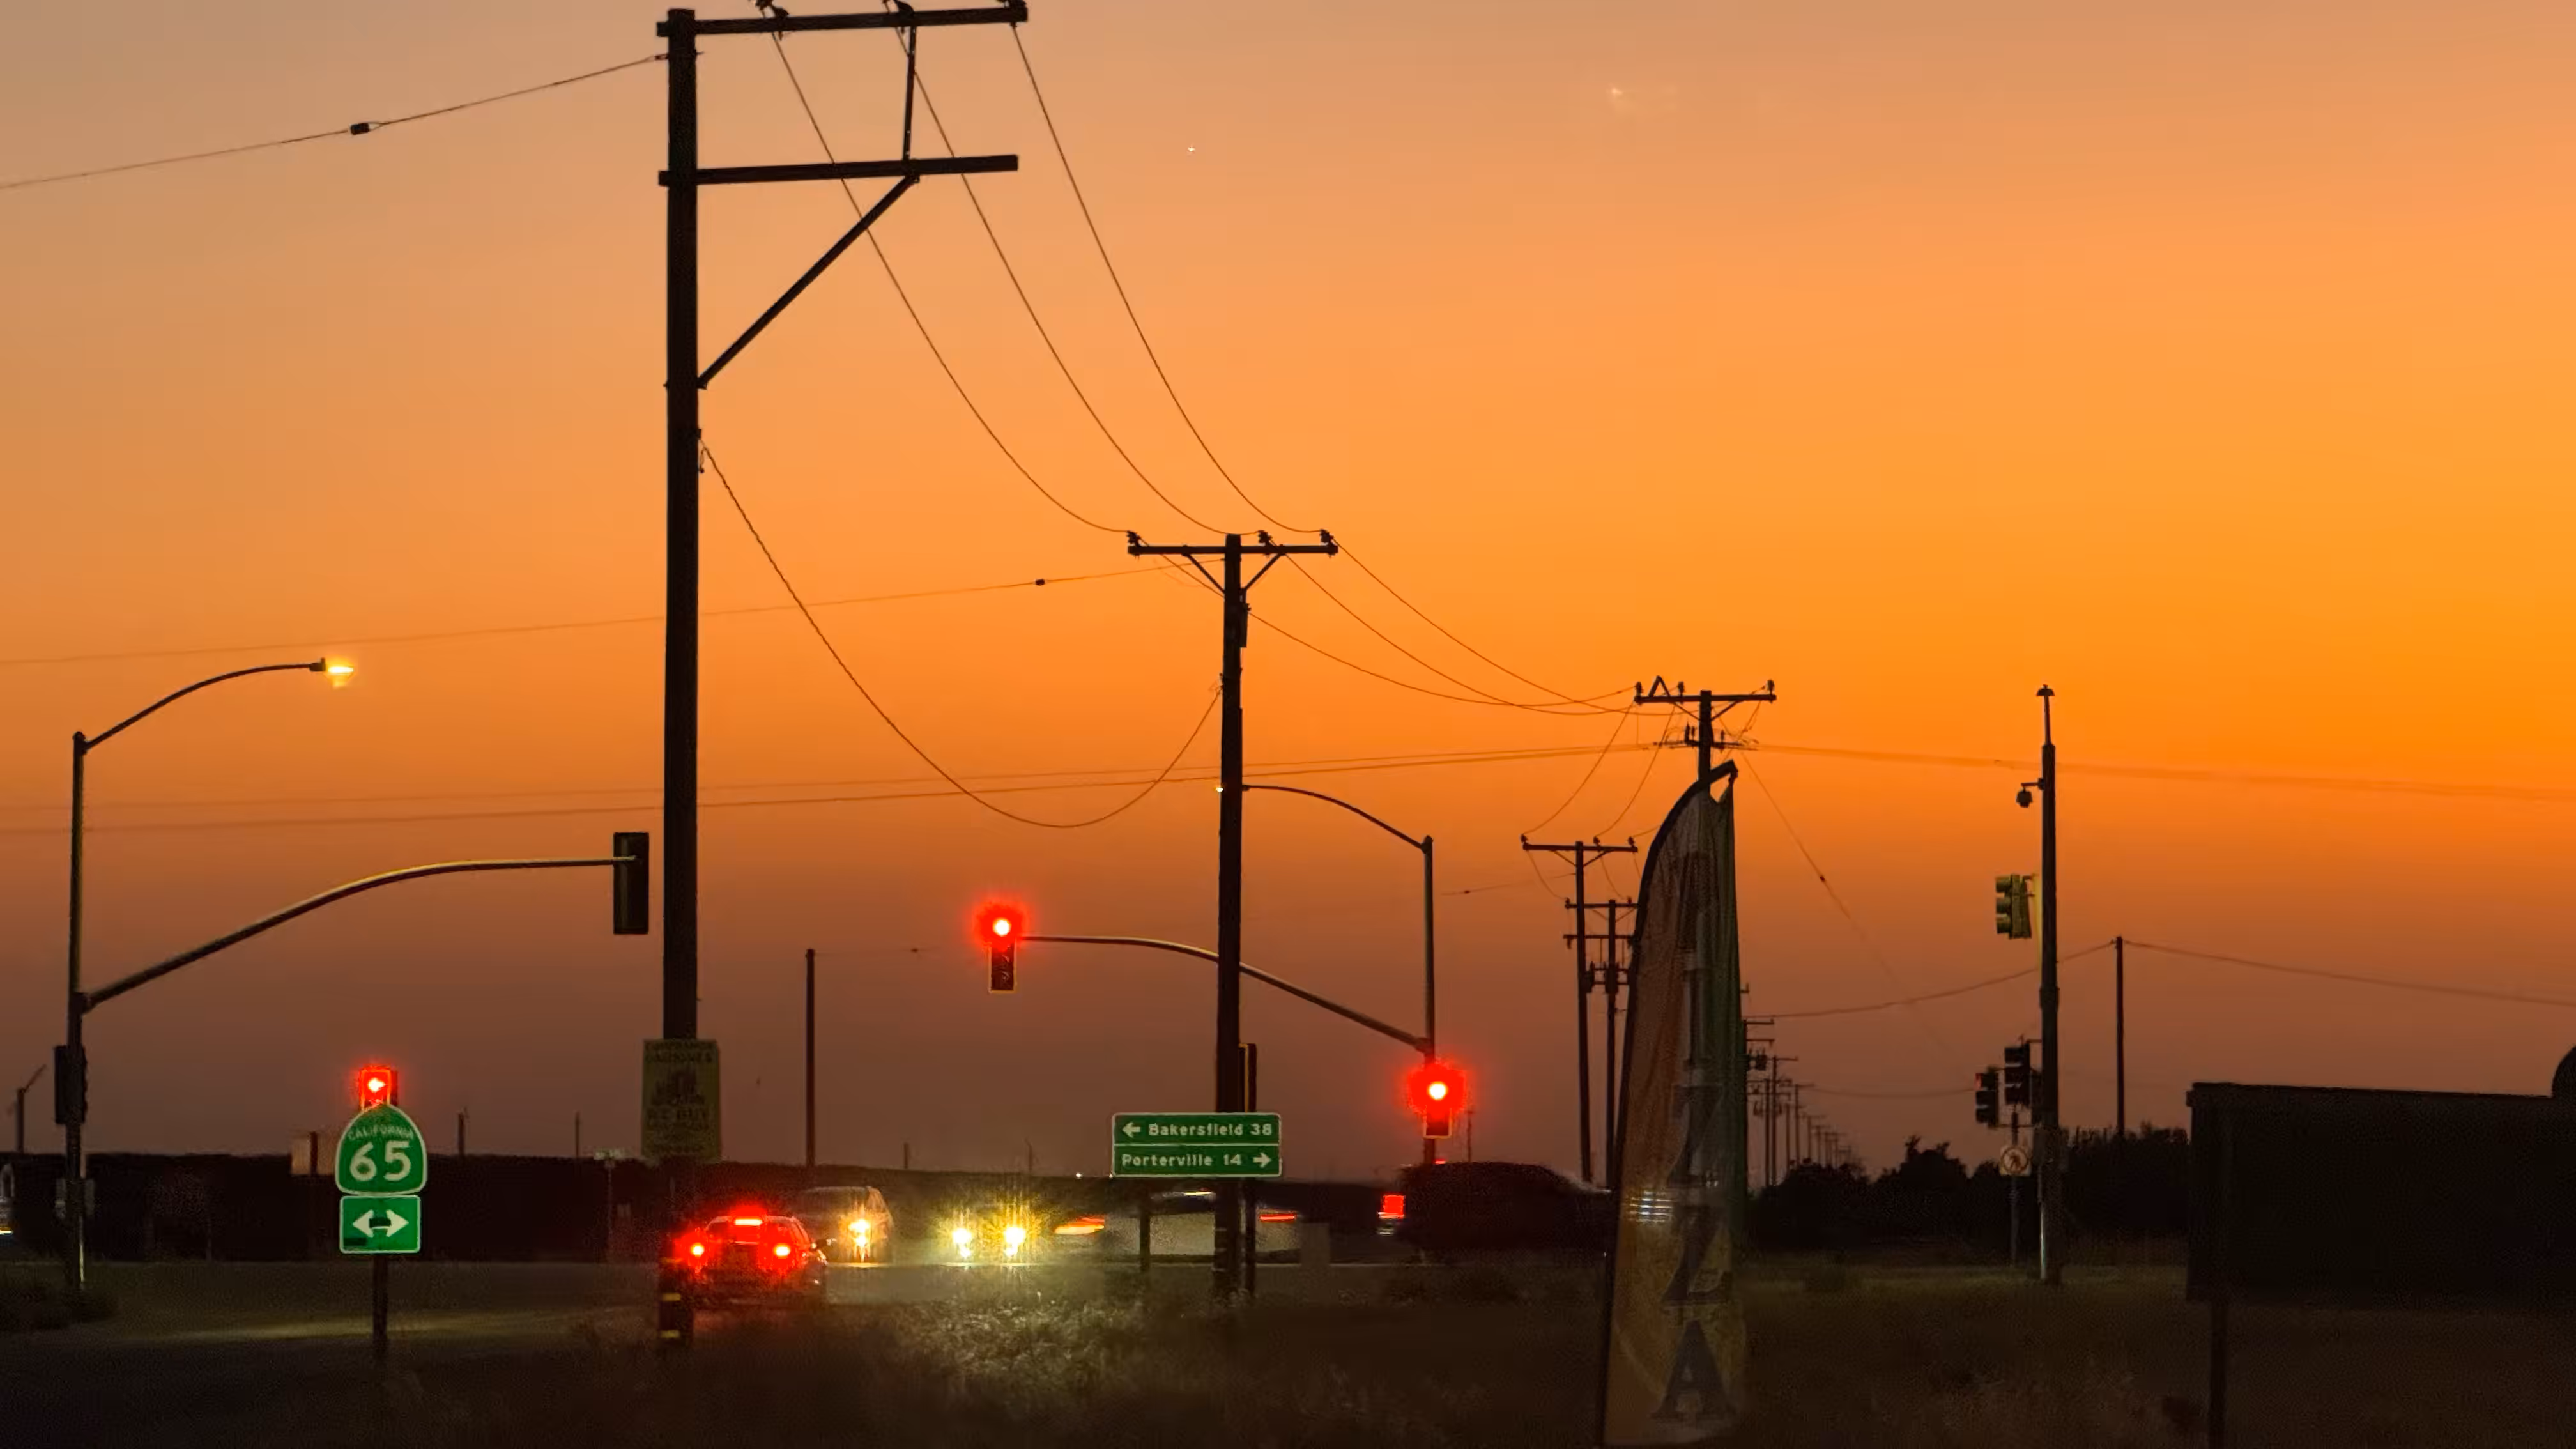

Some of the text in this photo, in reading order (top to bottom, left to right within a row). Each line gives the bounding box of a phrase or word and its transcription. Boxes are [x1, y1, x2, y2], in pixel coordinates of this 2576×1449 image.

[348, 1123, 414, 1140] CALIFORNIA
[1148, 1122, 1273, 1137] Bakersfield 38
[349, 1140, 411, 1182] 65
[1121, 1153, 1242, 1167] Porterville 14
